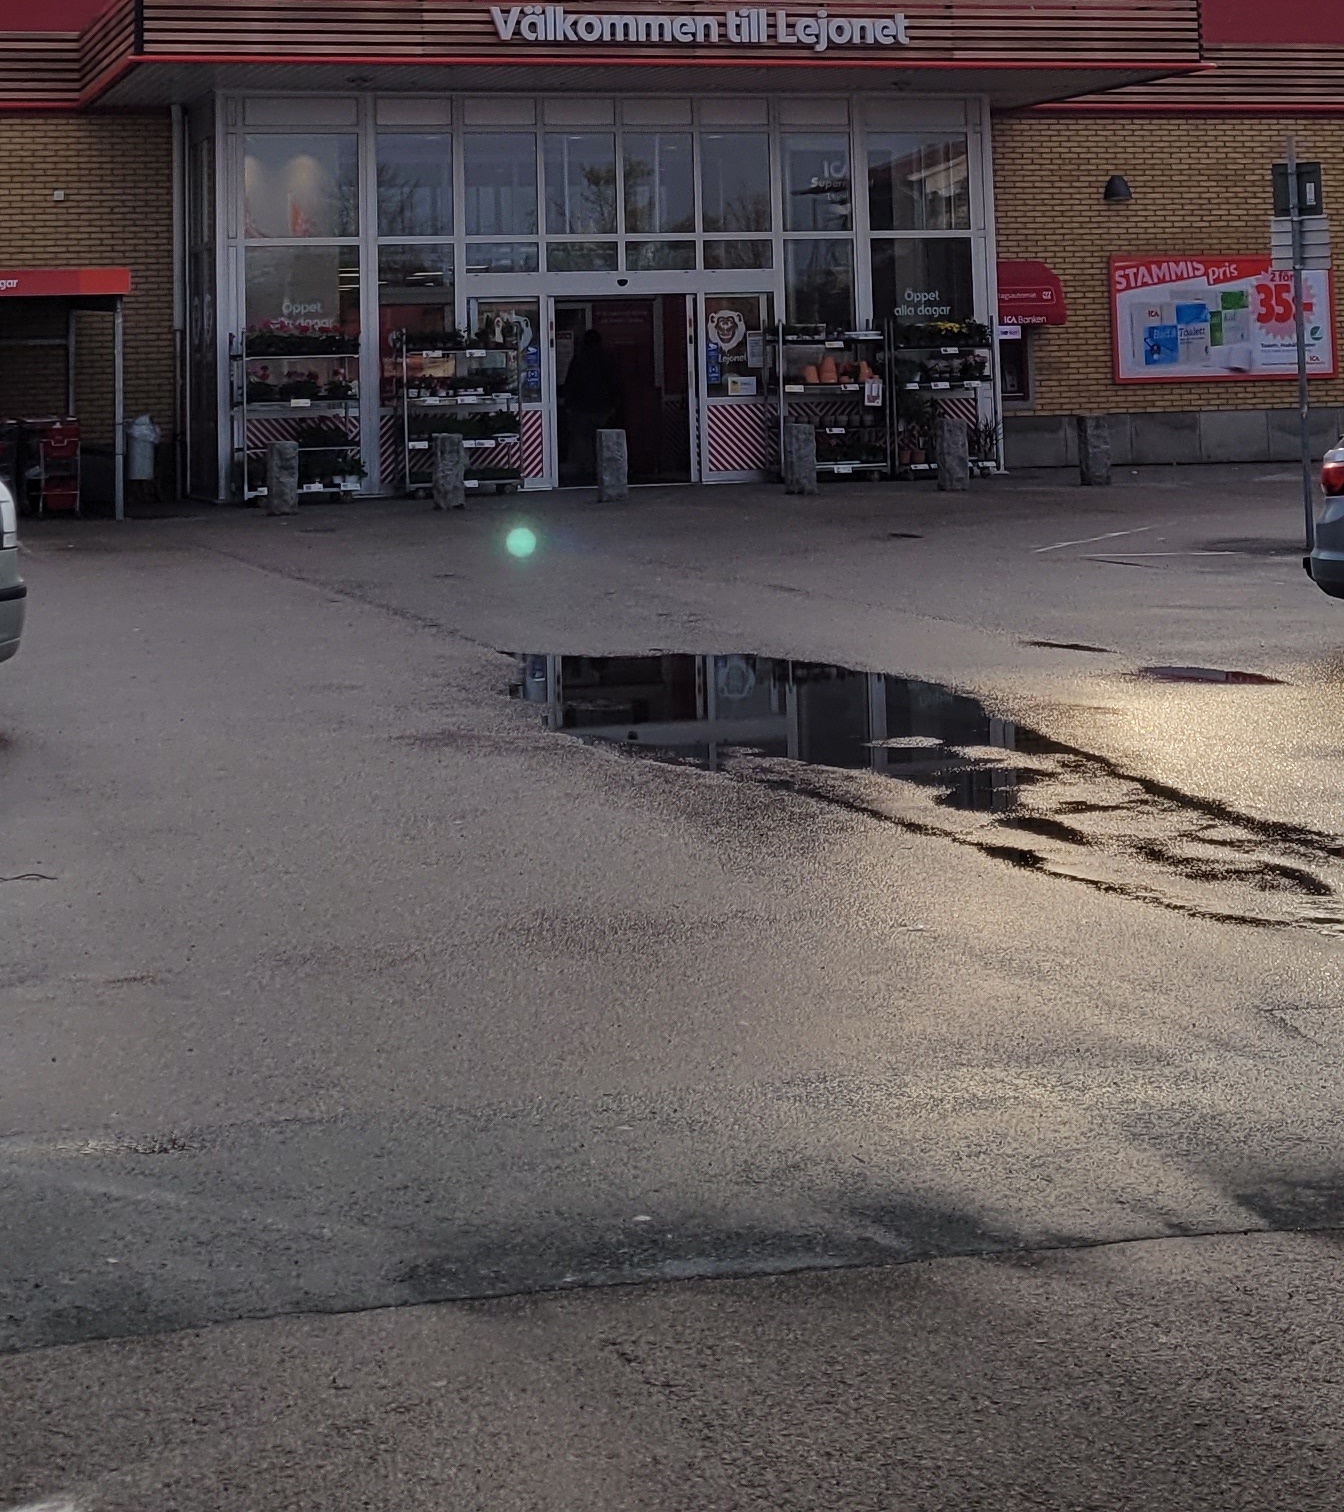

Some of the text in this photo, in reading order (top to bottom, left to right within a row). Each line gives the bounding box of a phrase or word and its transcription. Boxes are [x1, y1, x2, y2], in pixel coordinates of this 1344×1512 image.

[489, 5, 910, 52] Välkommen till Lejonet
[1115, 261, 1239, 290] STAMMIS pris
[1269, 272, 1277, 282] 2
[904, 288, 941, 303] Öppet
[894, 304, 951, 318] alla dagar
[1004, 315, 1047, 324] ICA Banken
